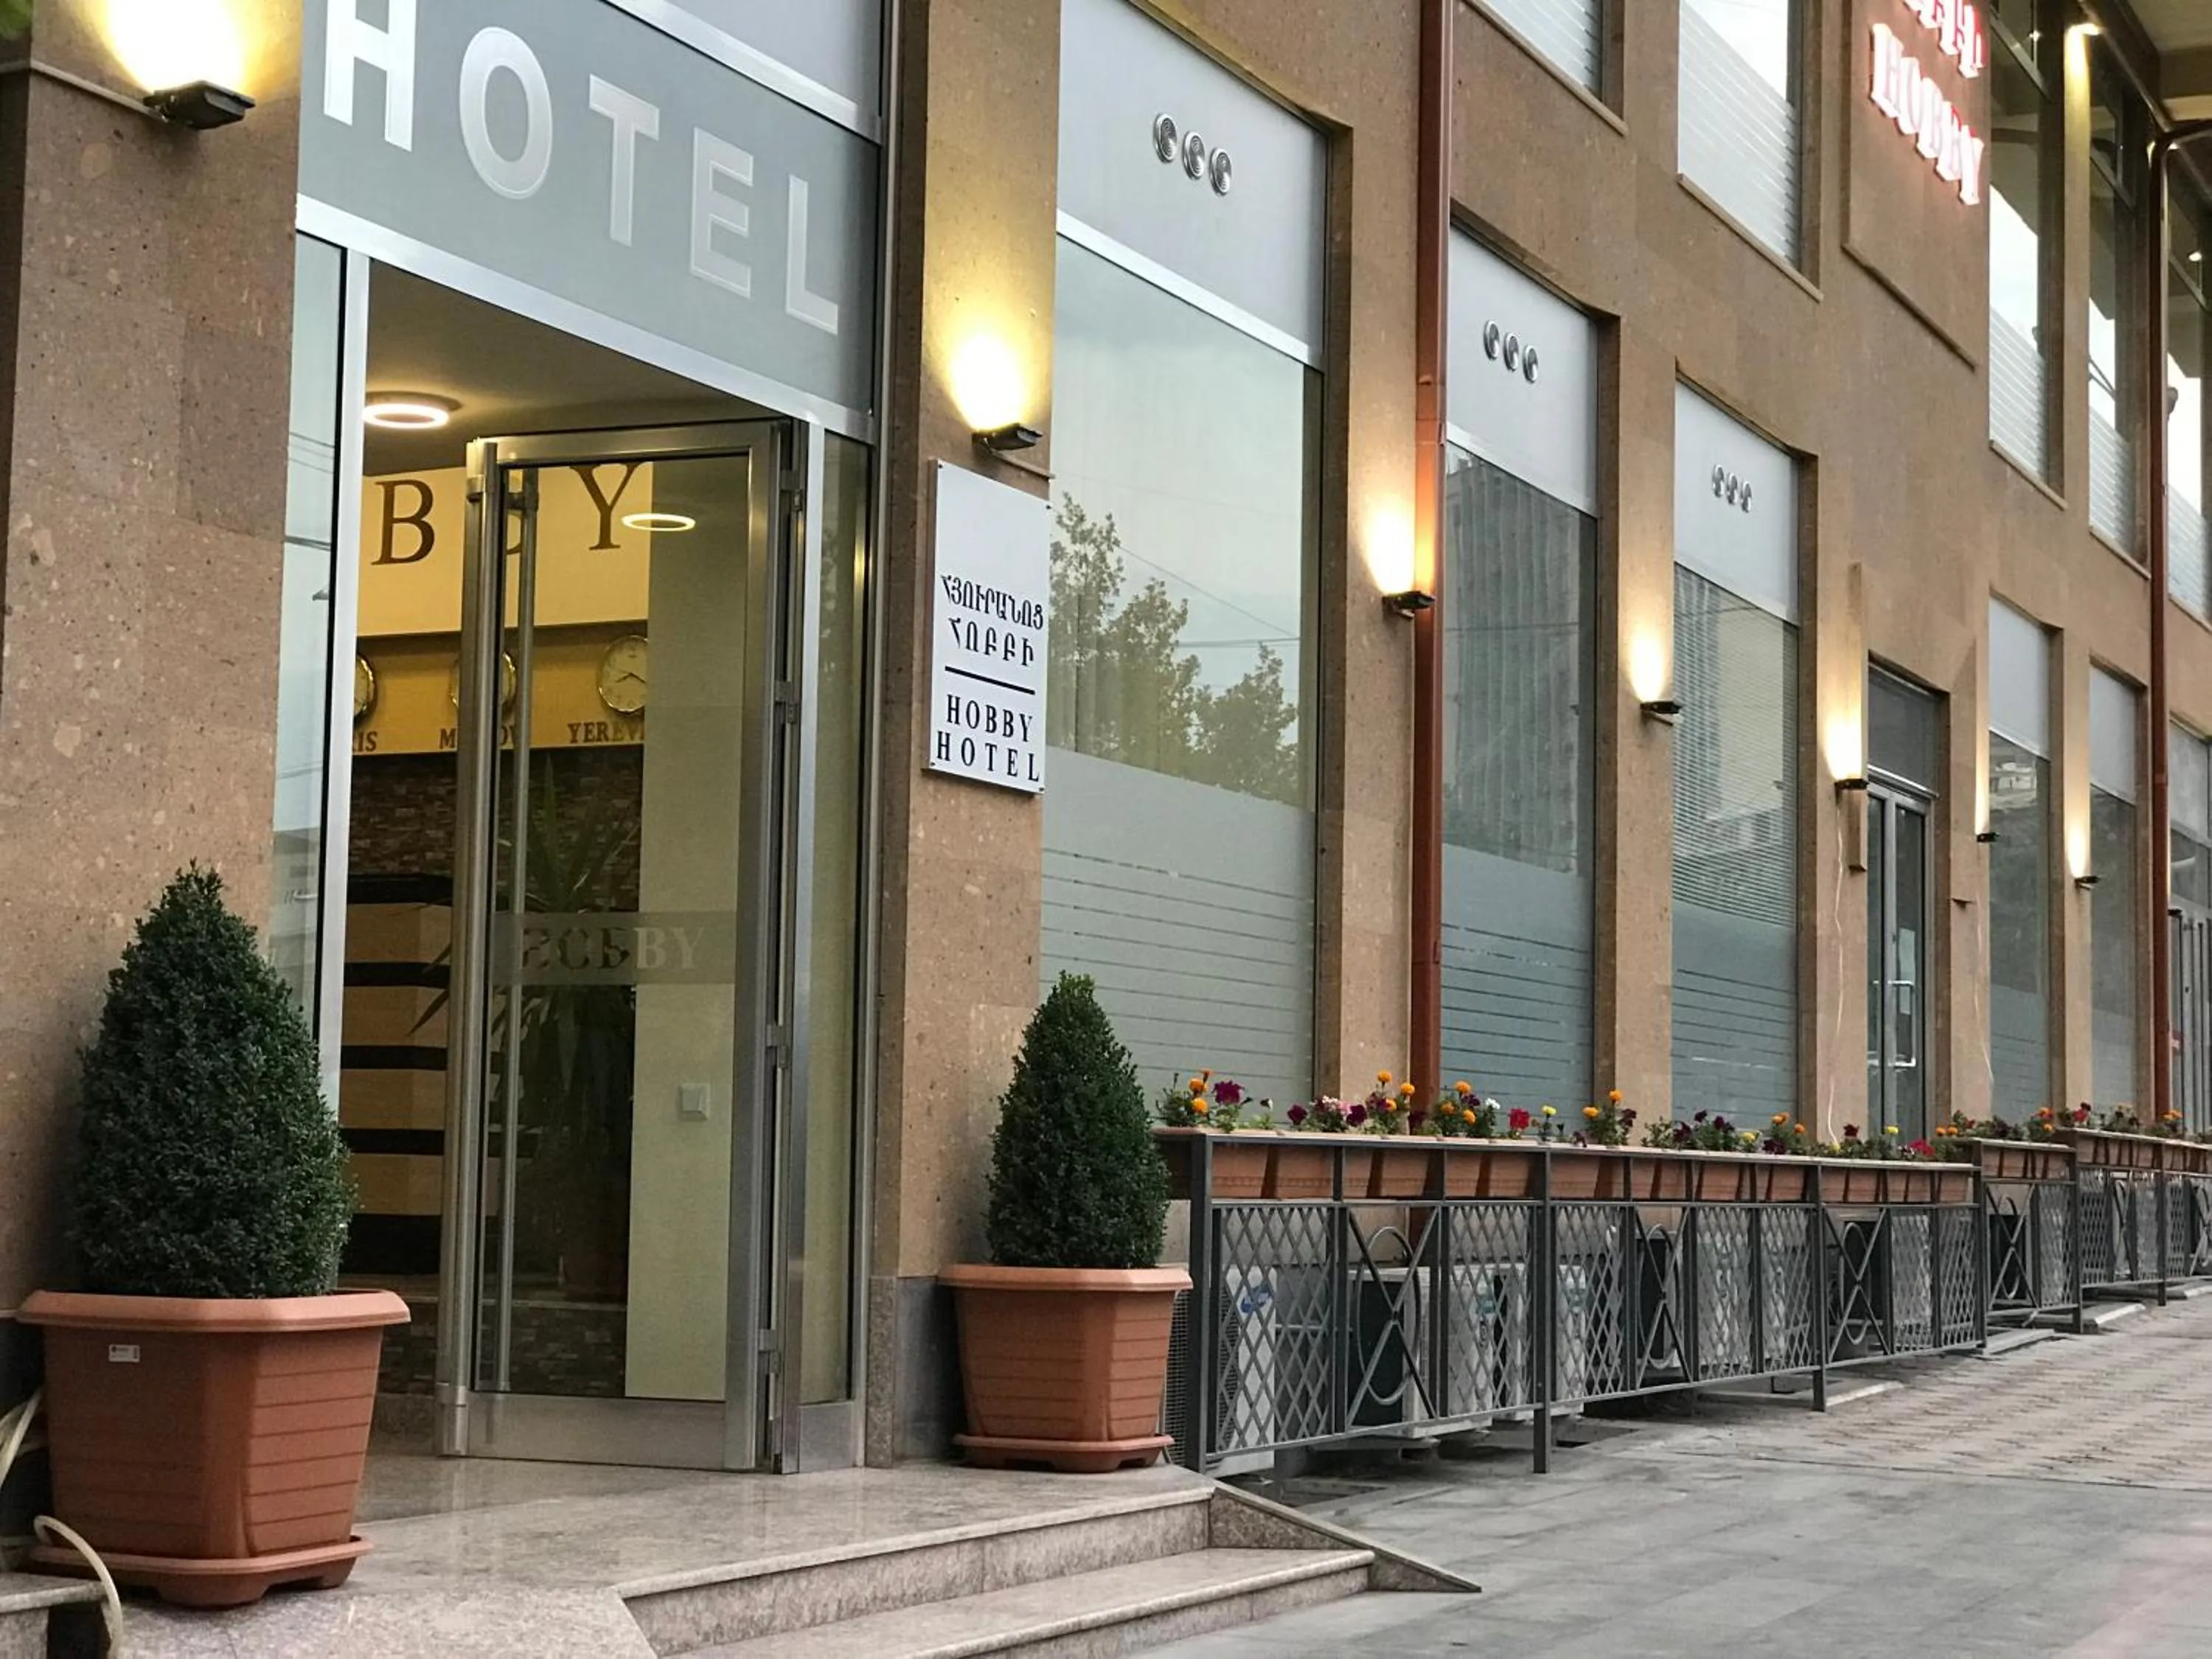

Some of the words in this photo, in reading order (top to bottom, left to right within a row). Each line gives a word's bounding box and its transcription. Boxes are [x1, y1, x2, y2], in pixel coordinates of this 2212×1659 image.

[324, 0, 838, 335] HOTEL
[940, 574, 1043, 630] ՀՅՈՒՐԱՆՈՑ
[947, 617, 1034, 667] ՀՈԲԲԻ
[567, 720, 644, 744] YEREV
[946, 694, 1033, 742] HOBBY
[936, 731, 1040, 782] HOTEL
